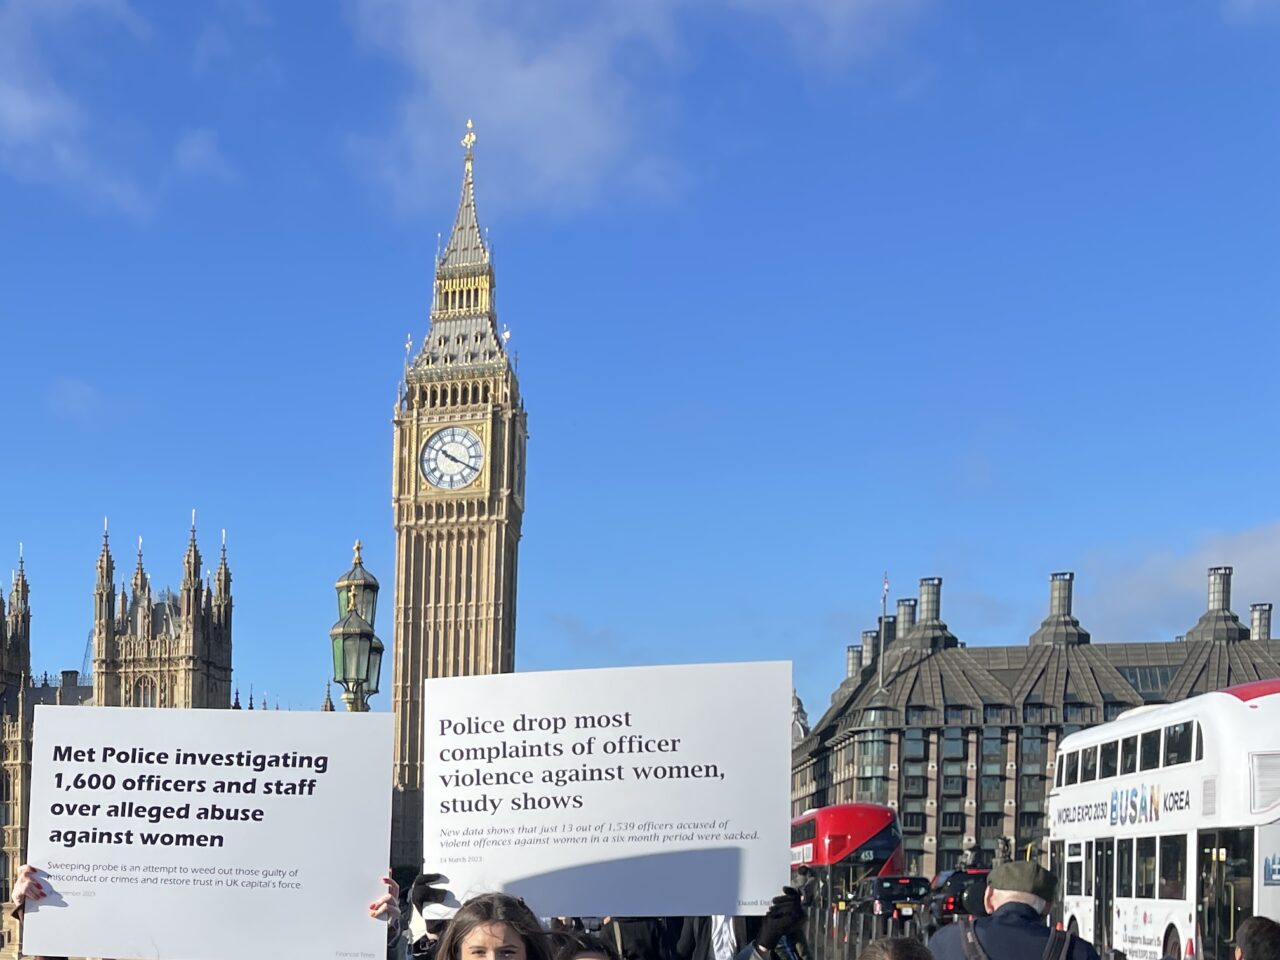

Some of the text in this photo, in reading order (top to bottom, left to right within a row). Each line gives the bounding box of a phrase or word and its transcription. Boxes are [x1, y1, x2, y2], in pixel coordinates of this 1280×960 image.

[440, 712, 632, 736] Police drop most
[440, 735, 680, 763] complaints of officer
[53, 746, 328, 774] Met Police investigating
[55, 773, 317, 795] 1,600 officers and staff
[439, 764, 724, 787] violence against women,
[50, 802, 264, 823] over alleged abuse
[440, 792, 583, 815] study shows
[1057, 783, 1190, 826] WORLD EXPO 2030 BUSAN KOREA
[49, 828, 224, 848] against women
[440, 820, 716, 837] New data shows that just out officers accused
[440, 839, 470, 848] violent
[473, 838, 511, 848] offences
[514, 837, 550, 846] against
[553, 836, 588, 844] women
[628, 832, 660, 842] month
[662, 832, 695, 843] period
[724, 830, 759, 840] sacked.
[860, 850, 874, 860] 453
[46, 874, 97, 883] misconduct
[110, 876, 138, 884] crimes
[140, 876, 158, 884] and
[160, 878, 190, 886] restore
[193, 878, 213, 886] trust
[225, 878, 239, 887] UK
[48, 861, 90, 872] Sweeping
[92, 864, 119, 872] probe
[142, 865, 177, 875] attempt
[190, 866, 216, 875] weed
[235, 868, 260, 876] those
[262, 869, 287, 879] guilty
